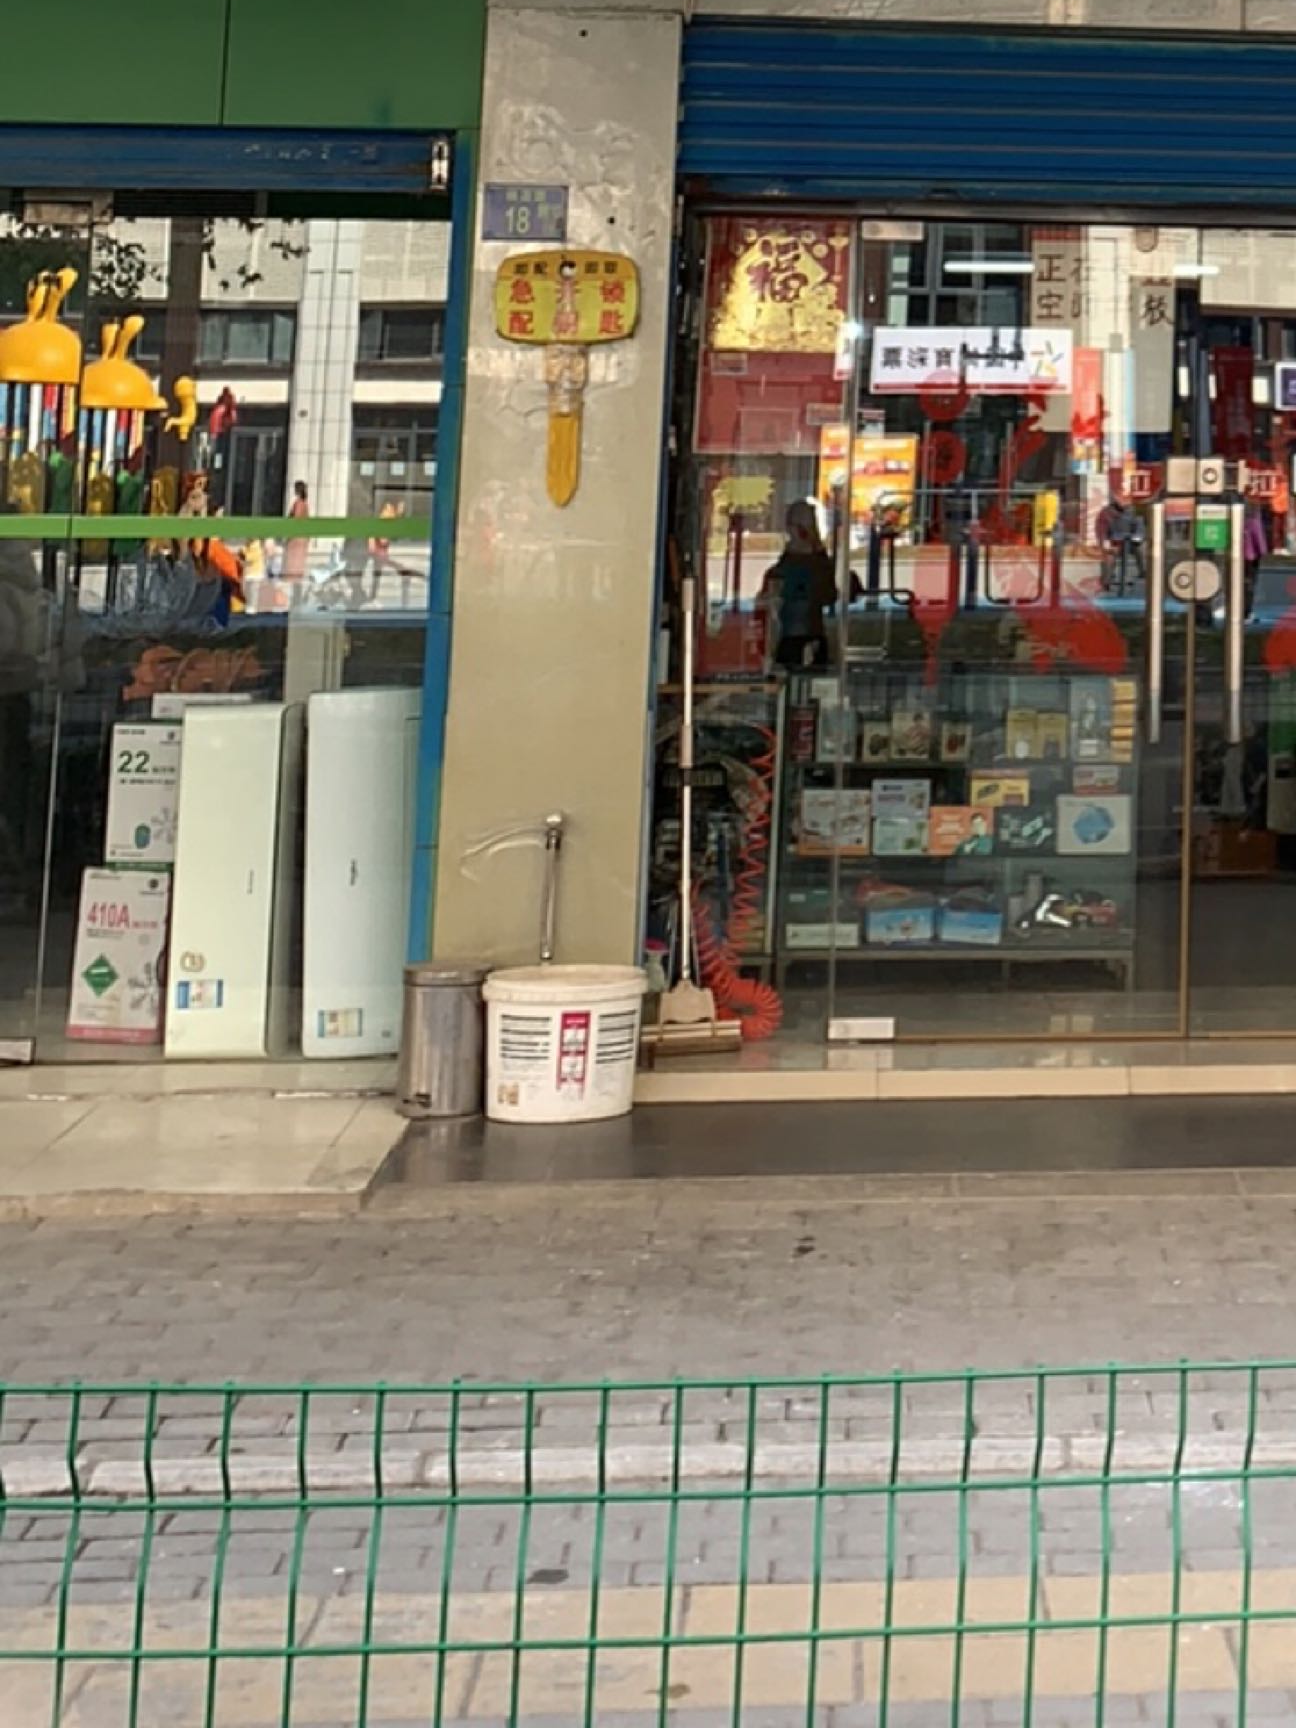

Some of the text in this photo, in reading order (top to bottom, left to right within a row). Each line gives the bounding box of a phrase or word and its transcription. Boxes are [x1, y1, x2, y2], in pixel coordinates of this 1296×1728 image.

[505, 205, 531, 234] 18
[117, 749, 151, 774] 22
[87, 901, 130, 930] 410A
